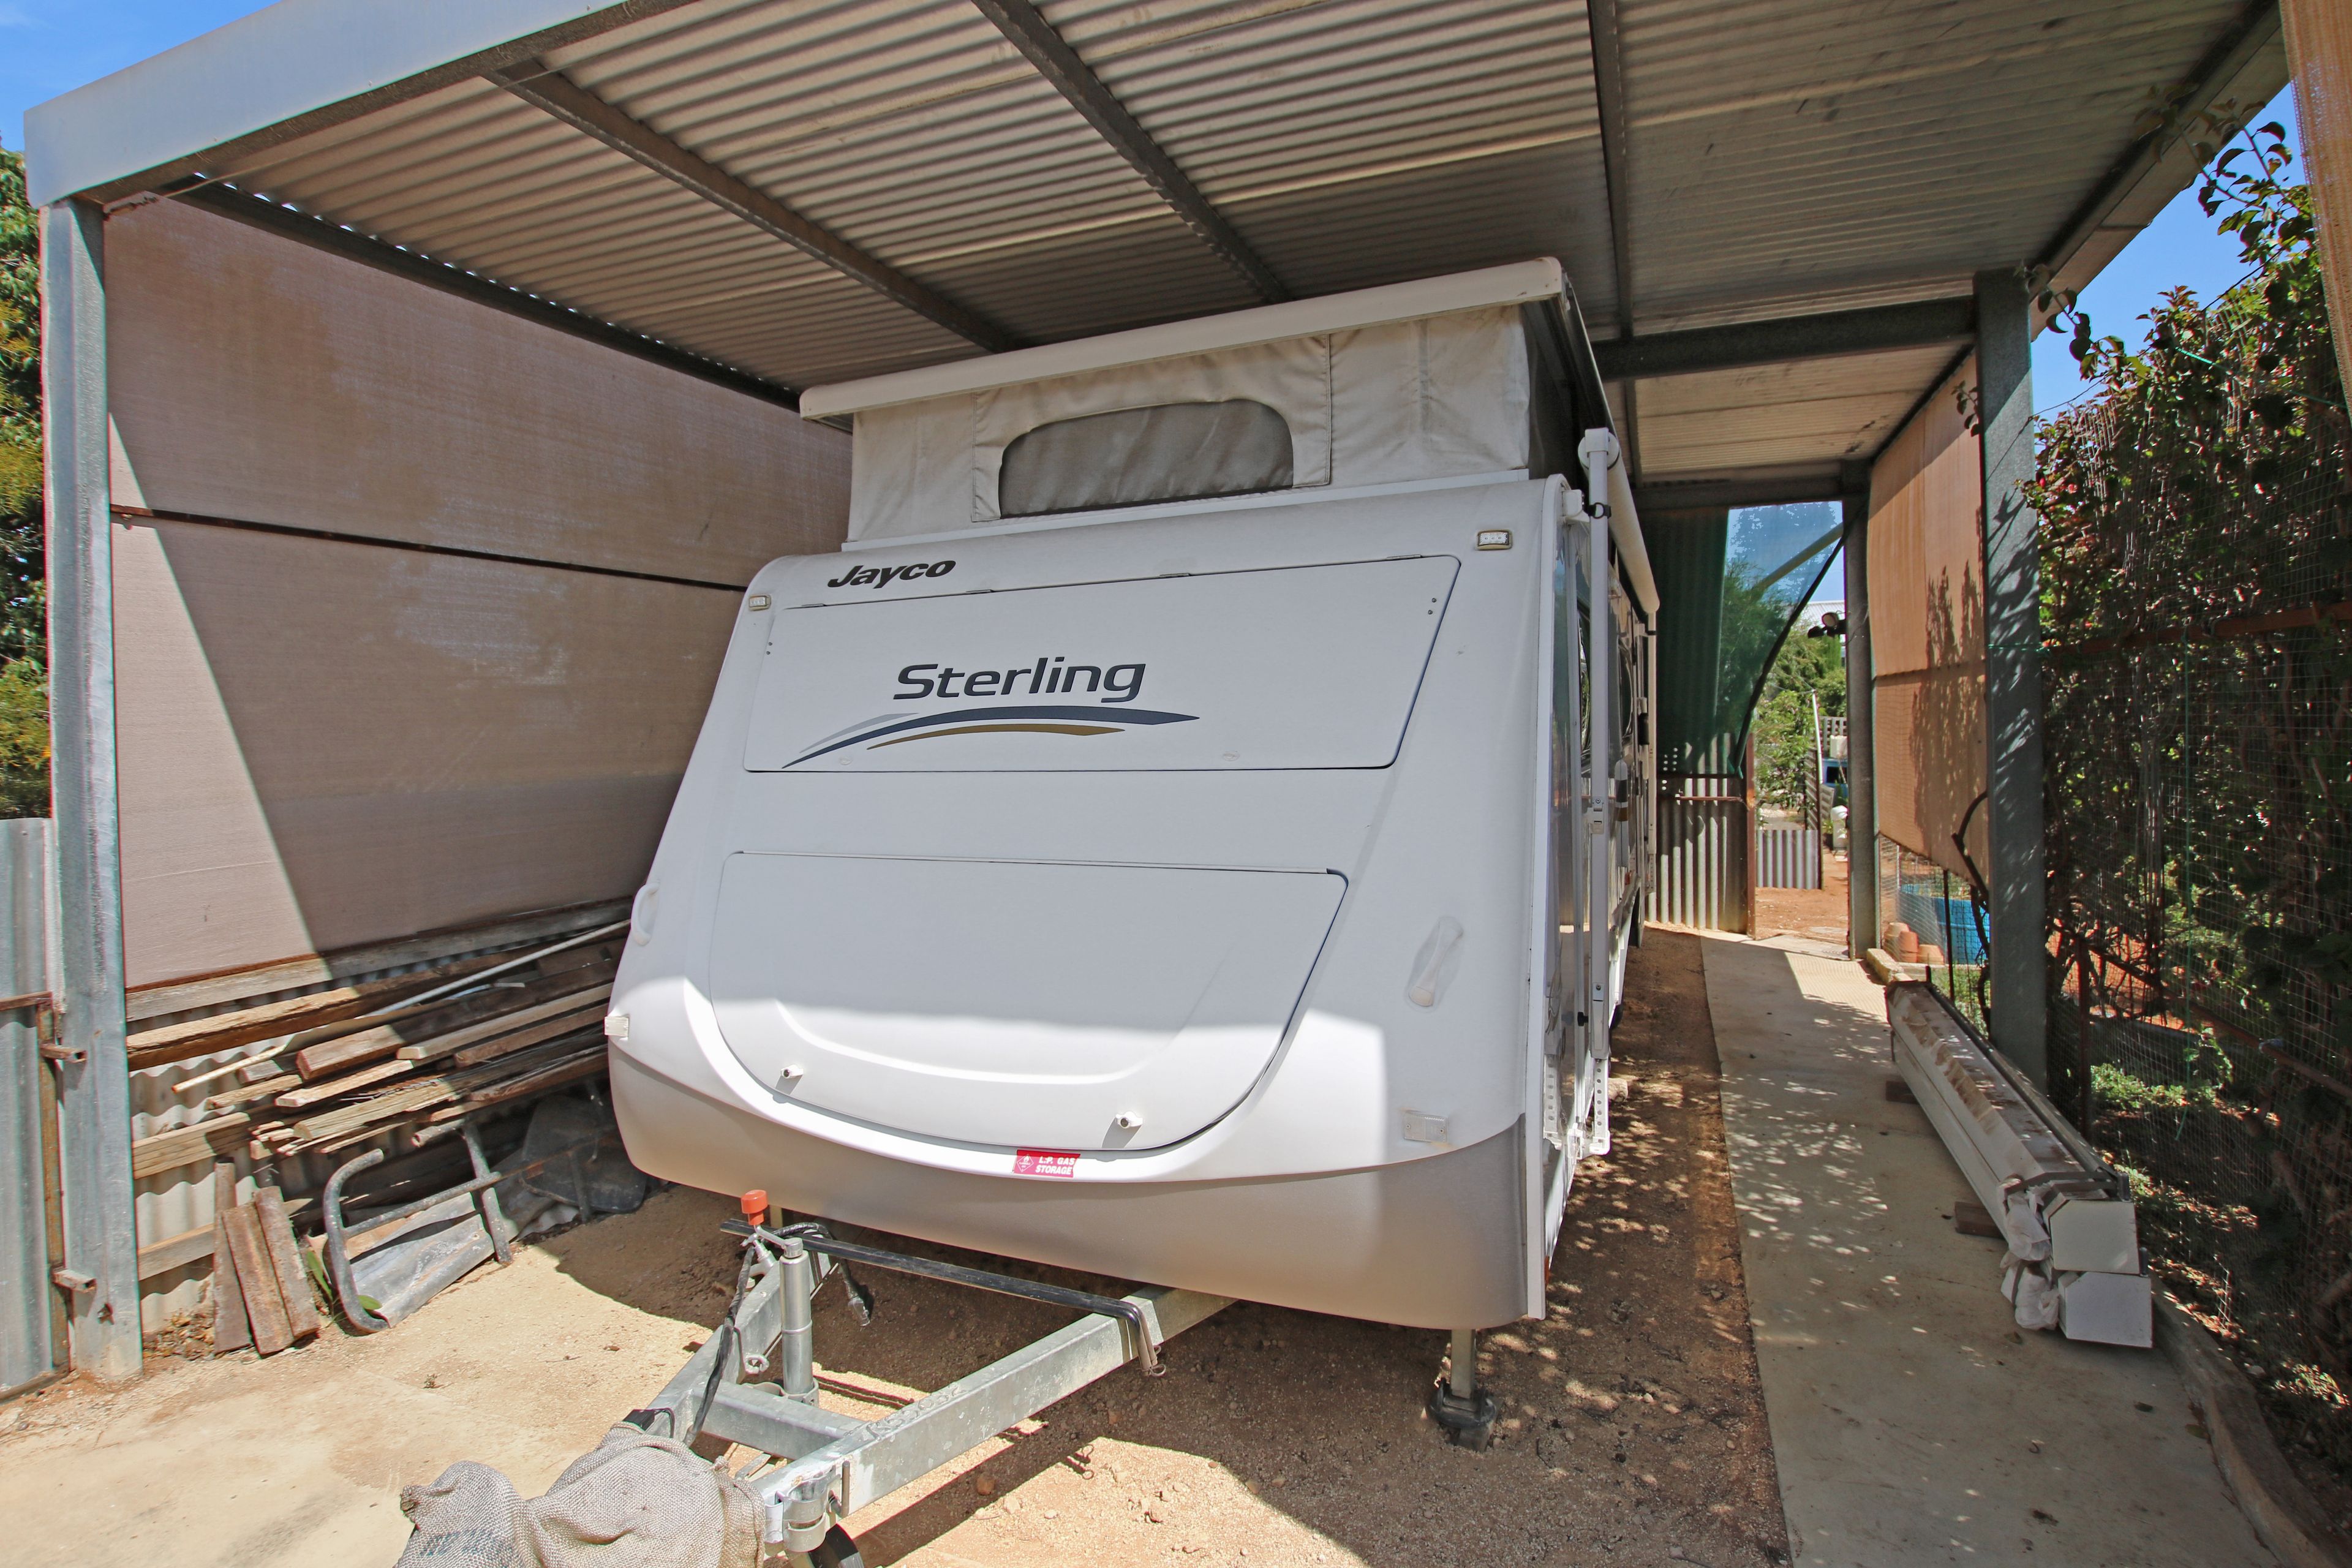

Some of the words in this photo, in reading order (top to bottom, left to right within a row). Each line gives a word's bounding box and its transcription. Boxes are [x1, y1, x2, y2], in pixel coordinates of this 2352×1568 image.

[827, 560, 956, 589] Jayco
[893, 656, 1146, 703] Sterling
[1035, 1165, 1072, 1175] STORAGE
